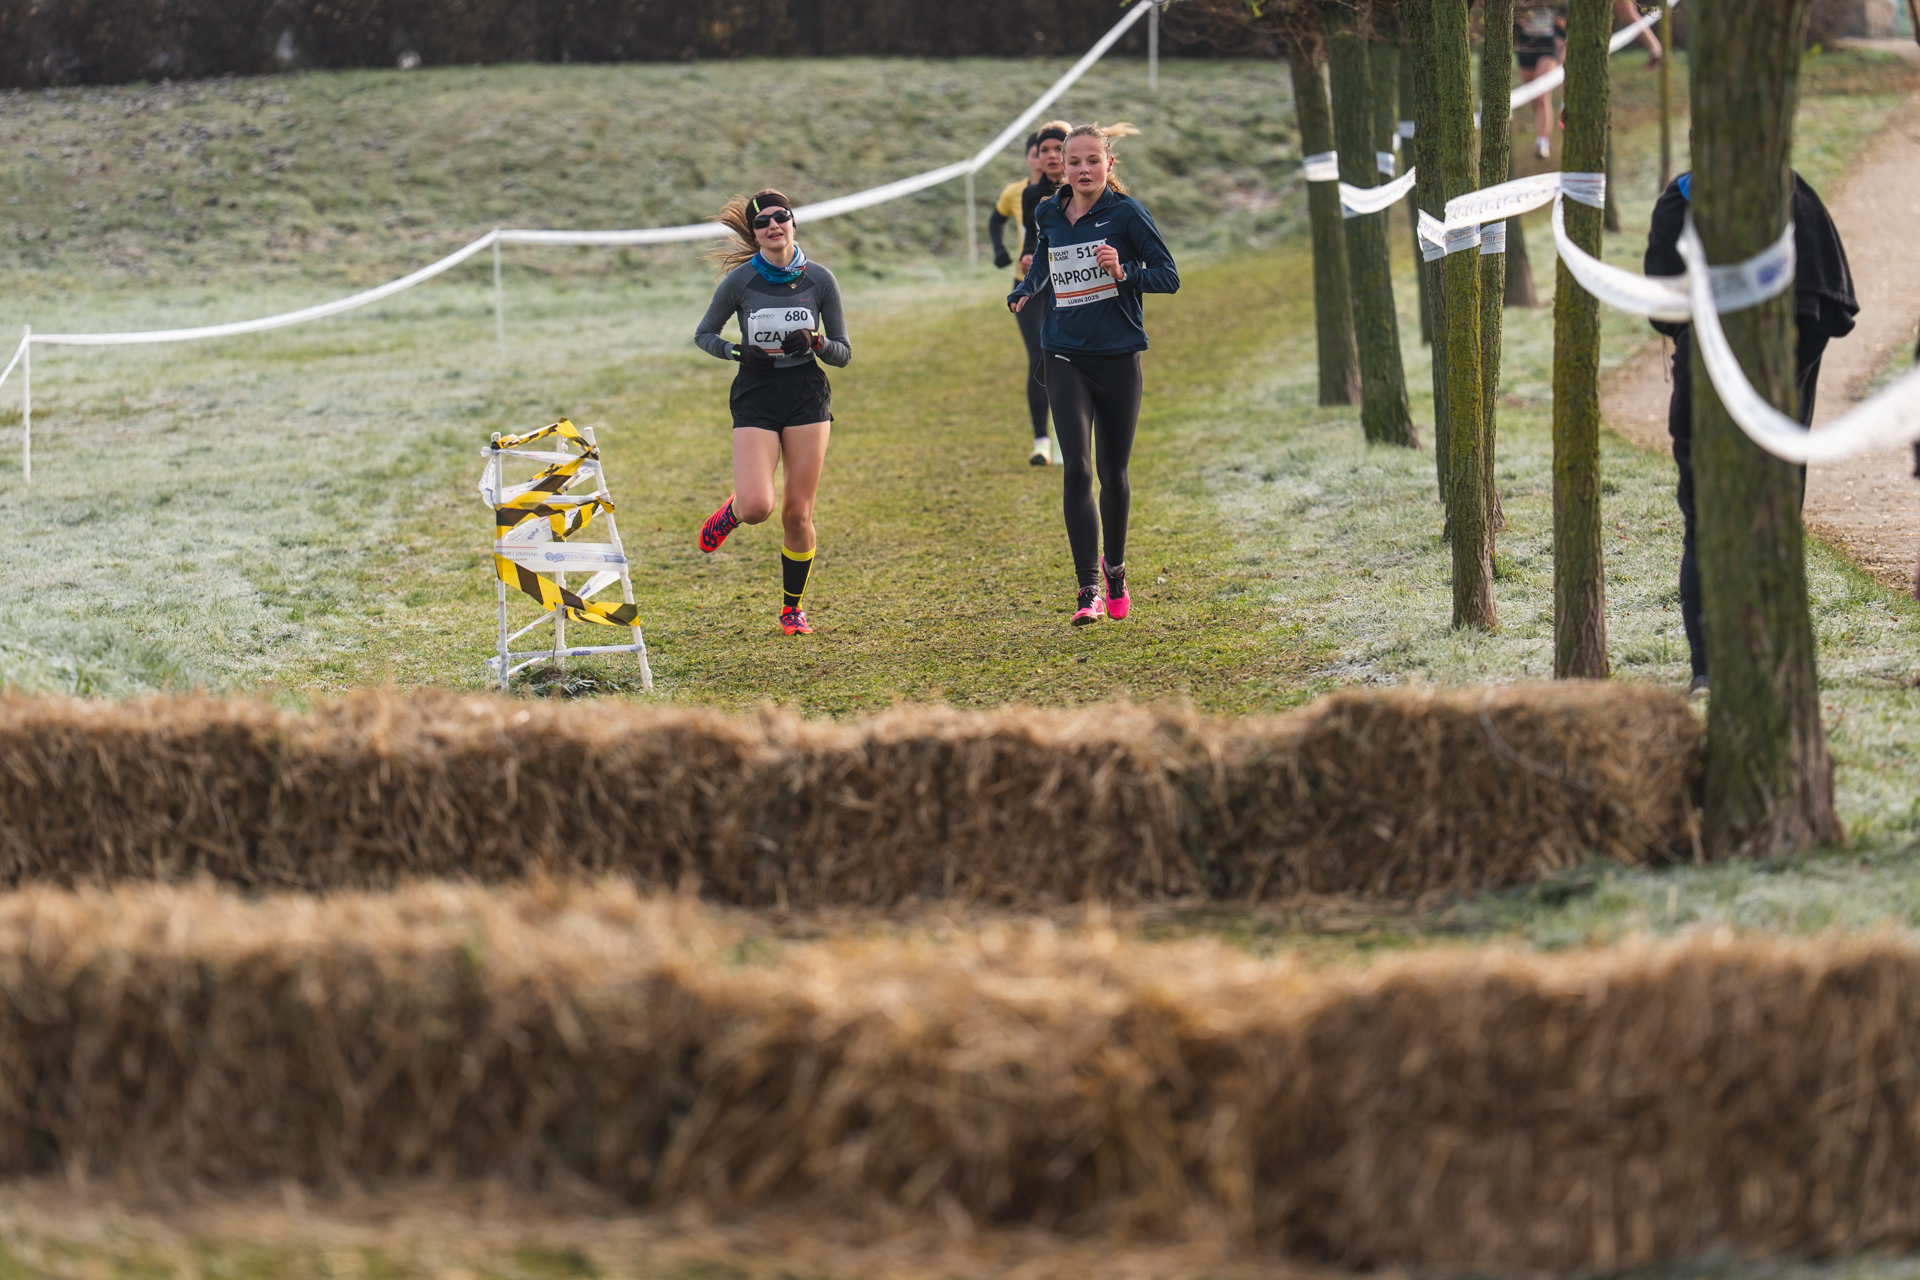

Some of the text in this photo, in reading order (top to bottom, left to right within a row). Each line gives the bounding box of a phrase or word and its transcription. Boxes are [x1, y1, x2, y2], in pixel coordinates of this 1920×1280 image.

[1052, 266, 1110, 286] PAPROTA
[1084, 294, 1100, 303] 2025
[784, 310, 808, 322] 680
